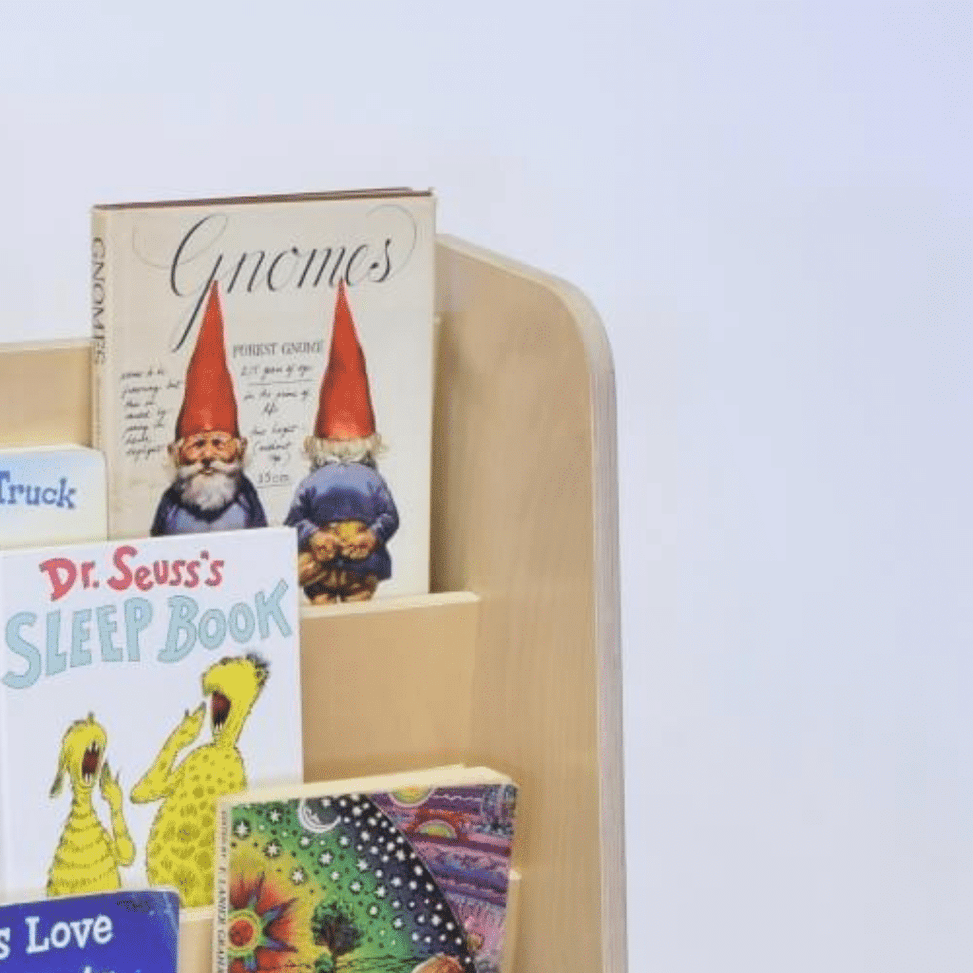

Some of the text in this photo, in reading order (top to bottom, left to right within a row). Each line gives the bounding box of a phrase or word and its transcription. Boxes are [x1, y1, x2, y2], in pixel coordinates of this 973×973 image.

[167, 208, 397, 353] Gnomes
[38, 556, 100, 602] Dr.
[0, 577, 293, 690] SLEEP BOOK
[25, 914, 114, 954] Love
